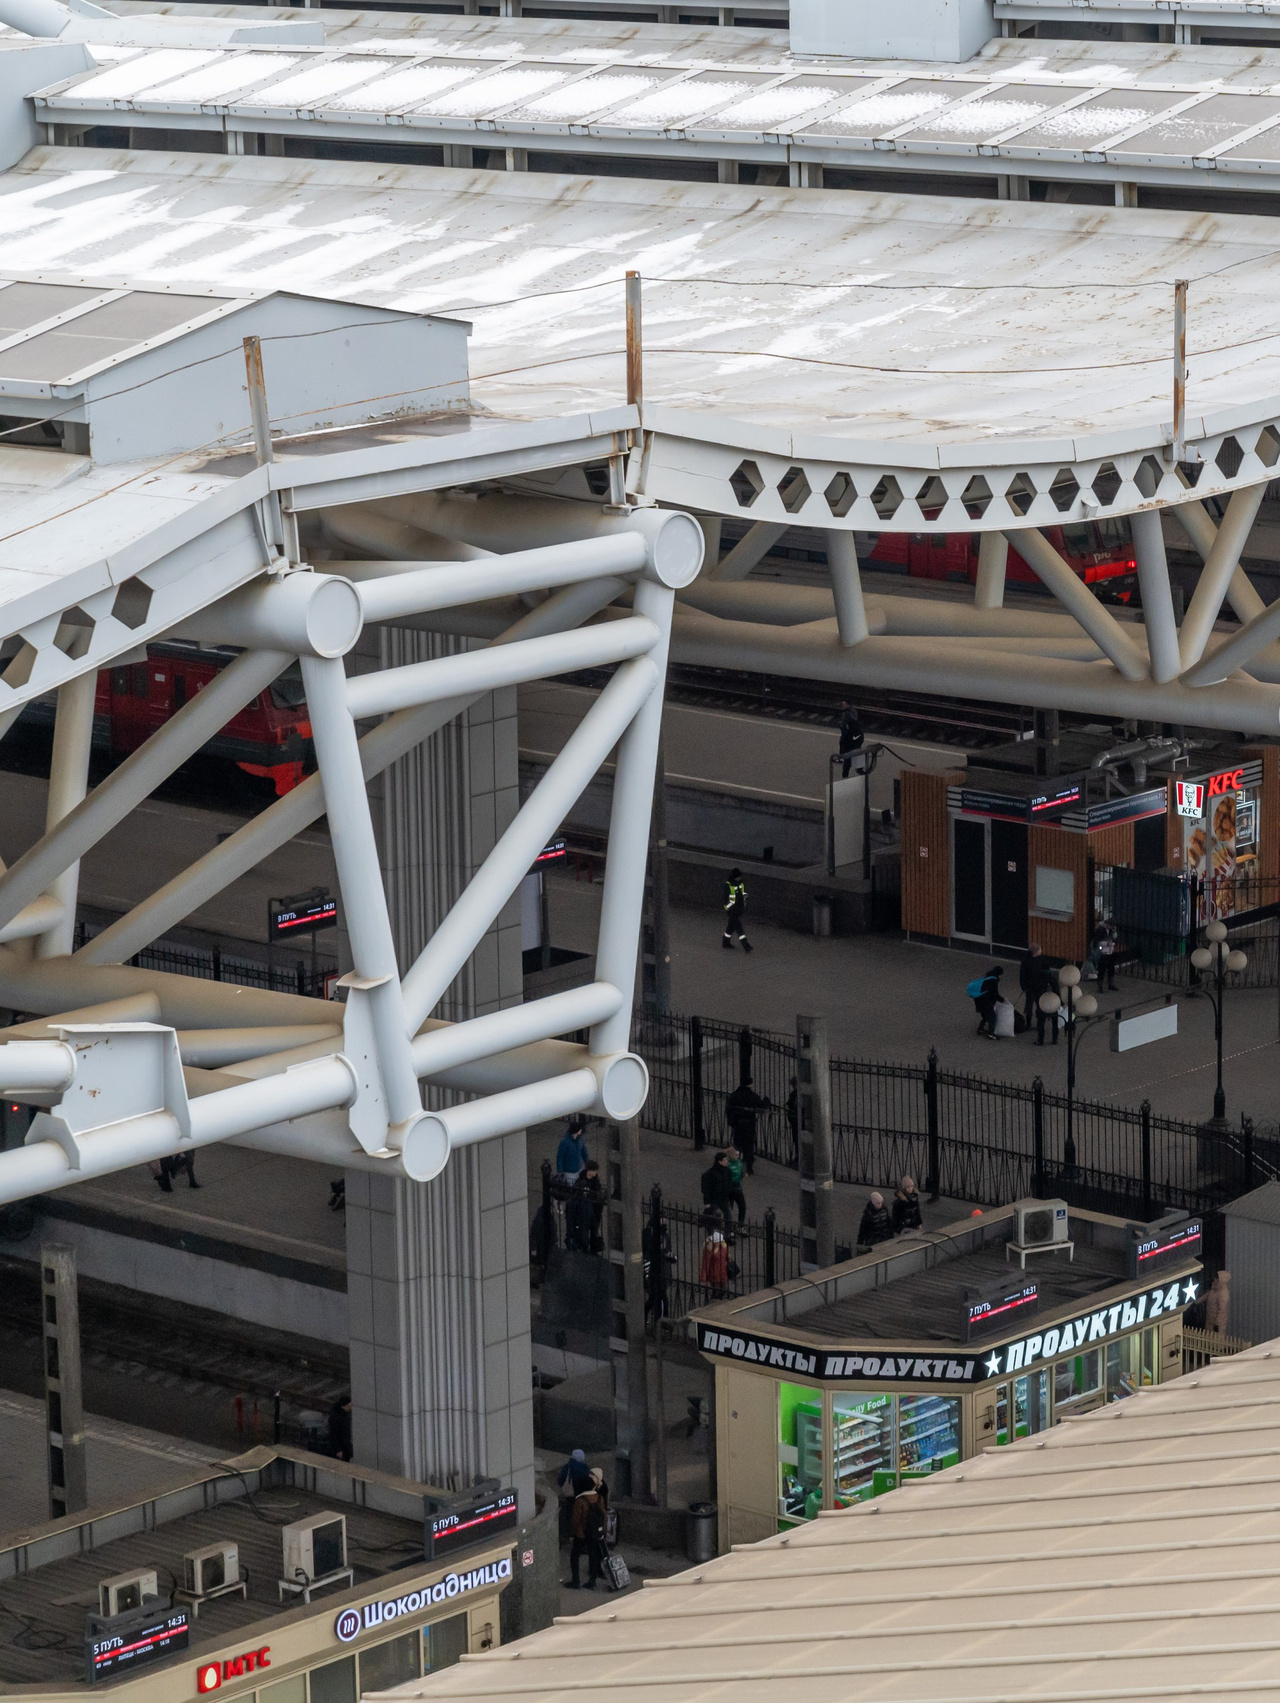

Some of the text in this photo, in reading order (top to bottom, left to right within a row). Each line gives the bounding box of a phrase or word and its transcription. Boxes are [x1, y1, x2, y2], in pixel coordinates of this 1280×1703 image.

[1207, 769, 1244, 797] KFC
[1181, 807, 1199, 816] KFC
[282, 912, 297, 921] ПУТЬ
[1187, 1224, 1199, 1235] 14:31
[1143, 1240, 1158, 1252] ПУТЬ
[1023, 1285, 1036, 1296] 14:31
[969, 1302, 991, 1317] 7 ПУТЬ
[1005, 1282, 1180, 1373] ПРОДУКТЫ 24
[704, 1330, 816, 1374] ПРОДУКТЫ
[824, 1356, 975, 1379] ПРОДУКТЫ
[867, 1395, 886, 1411] Food
[498, 1495, 514, 1507] 14:31
[433, 1515, 459, 1531] 6 ПУТЬ
[364, 1558, 511, 1629] Шоколадница
[167, 1614, 186, 1628] 14:31
[94, 1636, 124, 1654] 5 ПУТЬ
[224, 1646, 271, 1680] МТС
